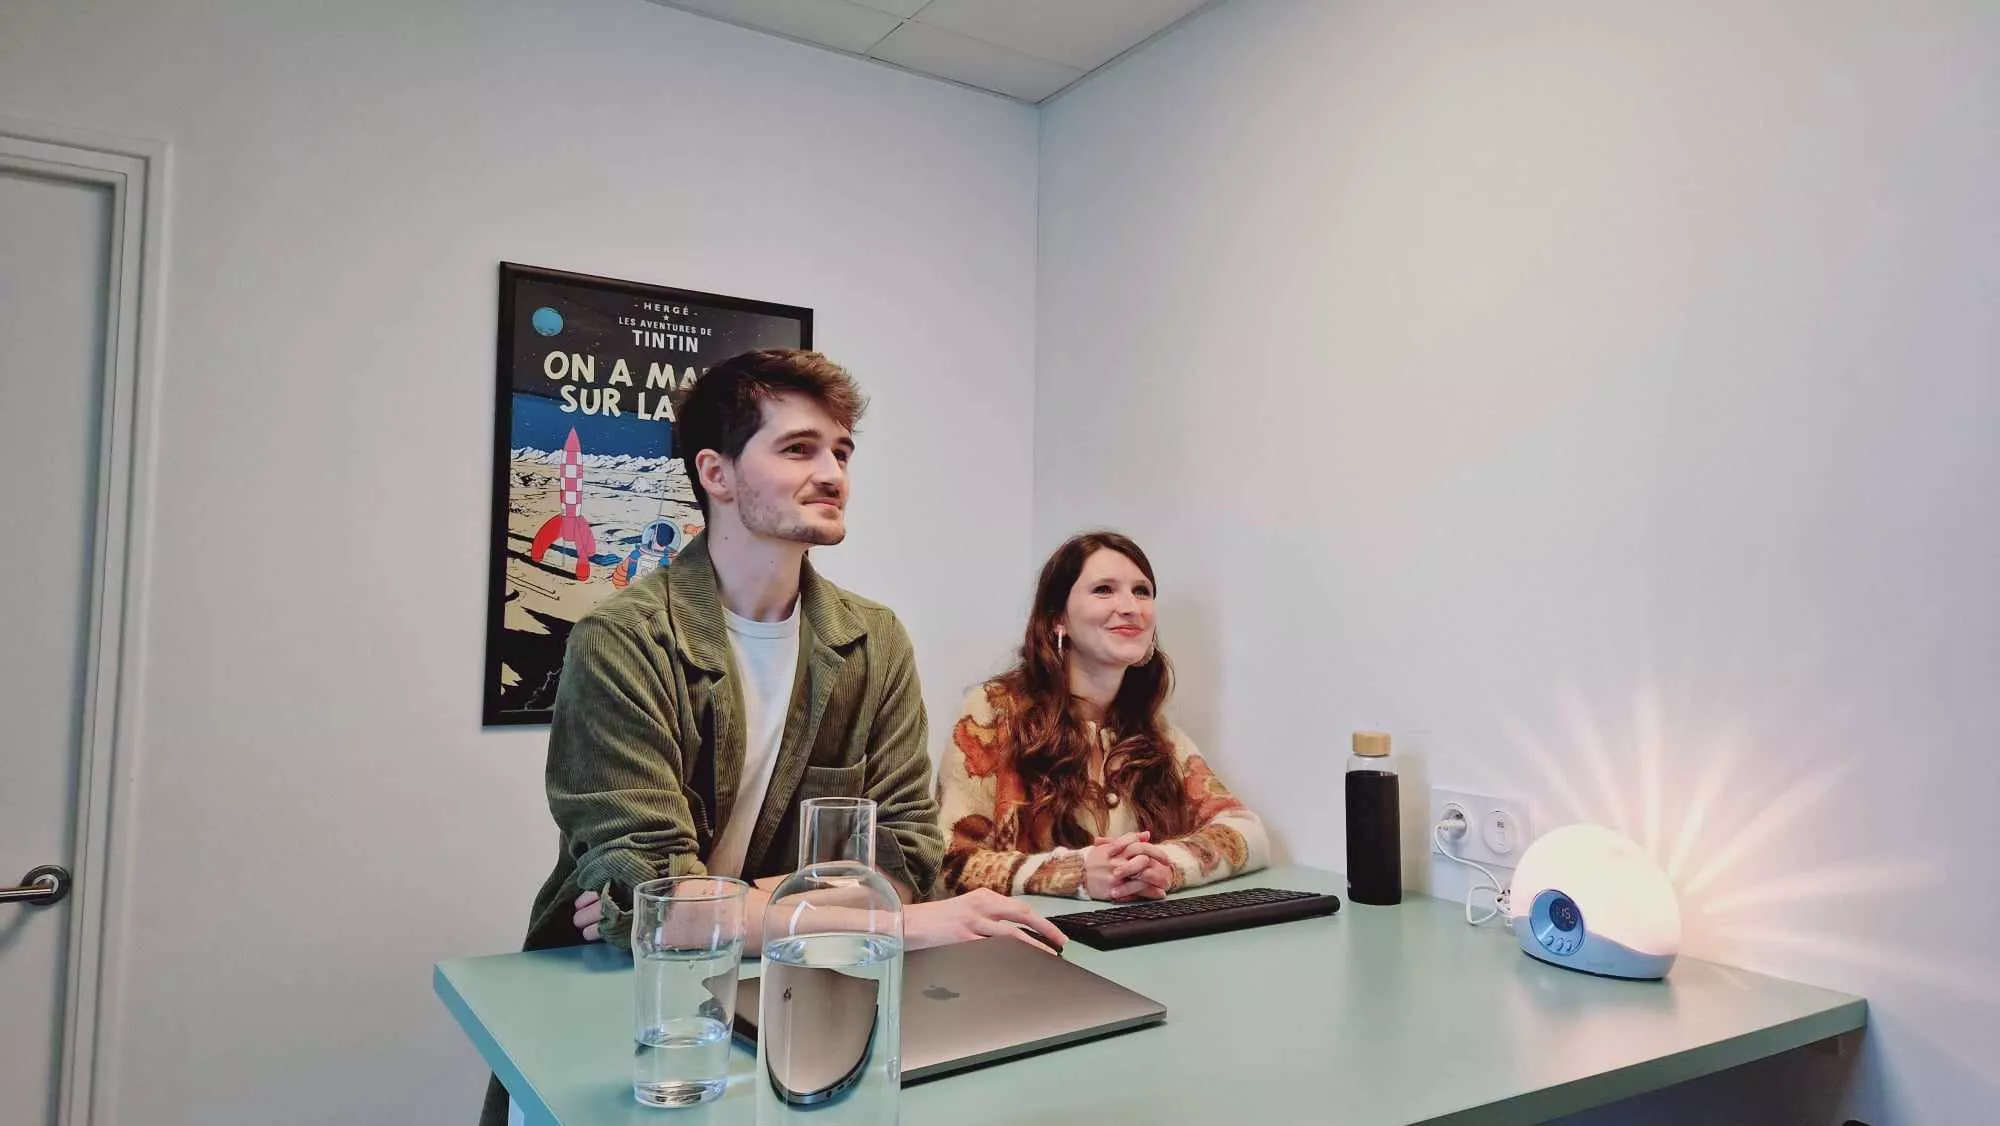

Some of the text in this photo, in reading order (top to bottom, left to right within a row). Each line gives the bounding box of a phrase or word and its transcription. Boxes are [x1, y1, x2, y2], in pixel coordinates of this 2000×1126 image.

[643, 301, 689, 316] HERGÉ
[618, 316, 712, 336] LES AVENTURES DE
[631, 329, 699, 353] TINTIN
[543, 350, 711, 392] ON A MA
[559, 384, 676, 423] SUR LA
